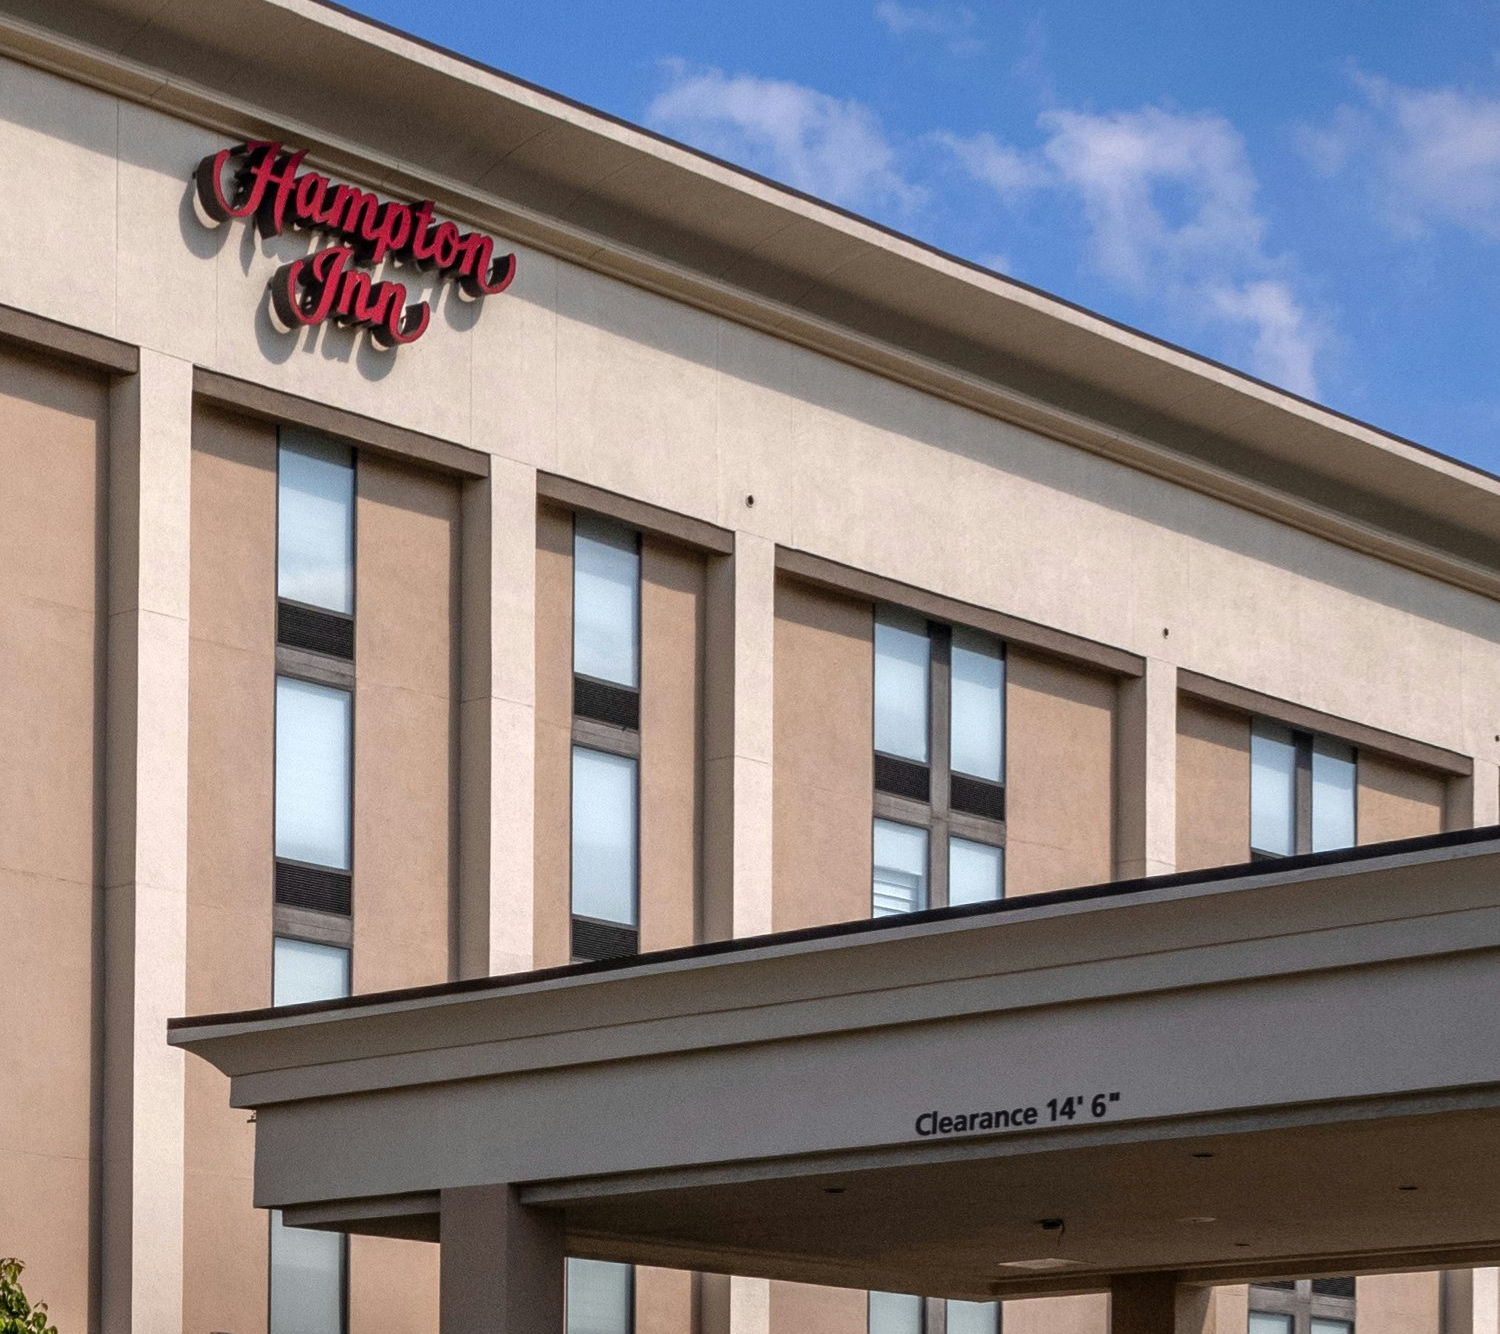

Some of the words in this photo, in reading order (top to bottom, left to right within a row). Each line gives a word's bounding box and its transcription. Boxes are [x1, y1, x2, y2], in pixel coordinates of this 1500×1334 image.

[200, 140, 517, 296] Hampton
[276, 245, 431, 345] Inn
[914, 1106, 1038, 1137] Clearance
[1046, 1095, 1084, 1122] 14'
